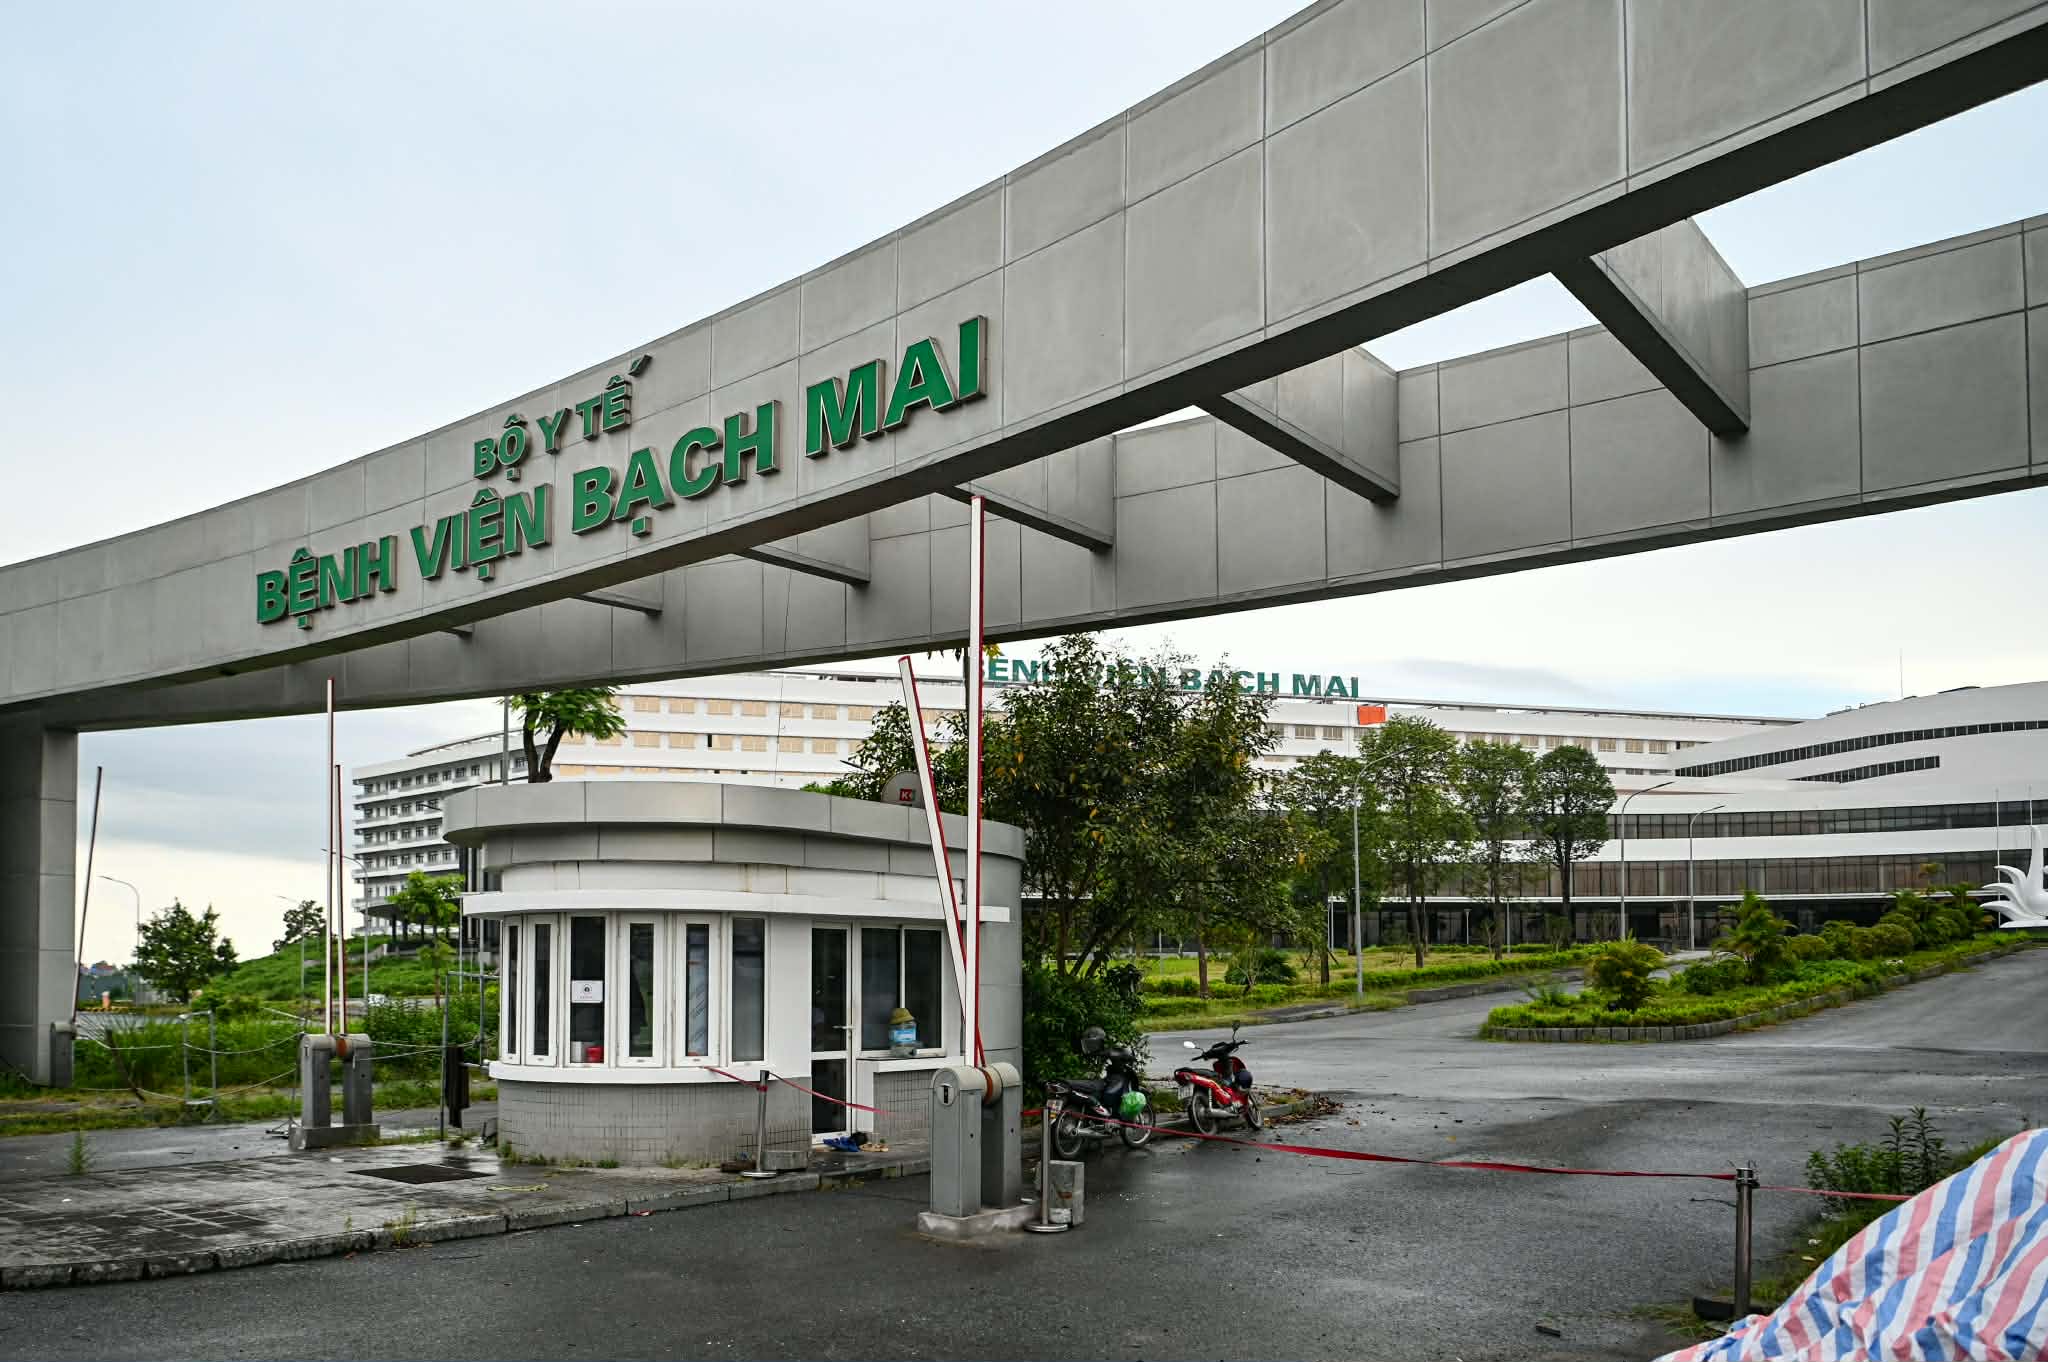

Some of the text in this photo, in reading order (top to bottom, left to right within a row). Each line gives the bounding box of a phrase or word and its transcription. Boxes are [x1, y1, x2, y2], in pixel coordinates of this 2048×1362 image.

[256, 315, 987, 629] BỆNH VIỆN BẠCH MAI
[474, 355, 652, 480] BỘ Y TẾ
[1292, 673, 1359, 698] MAI
